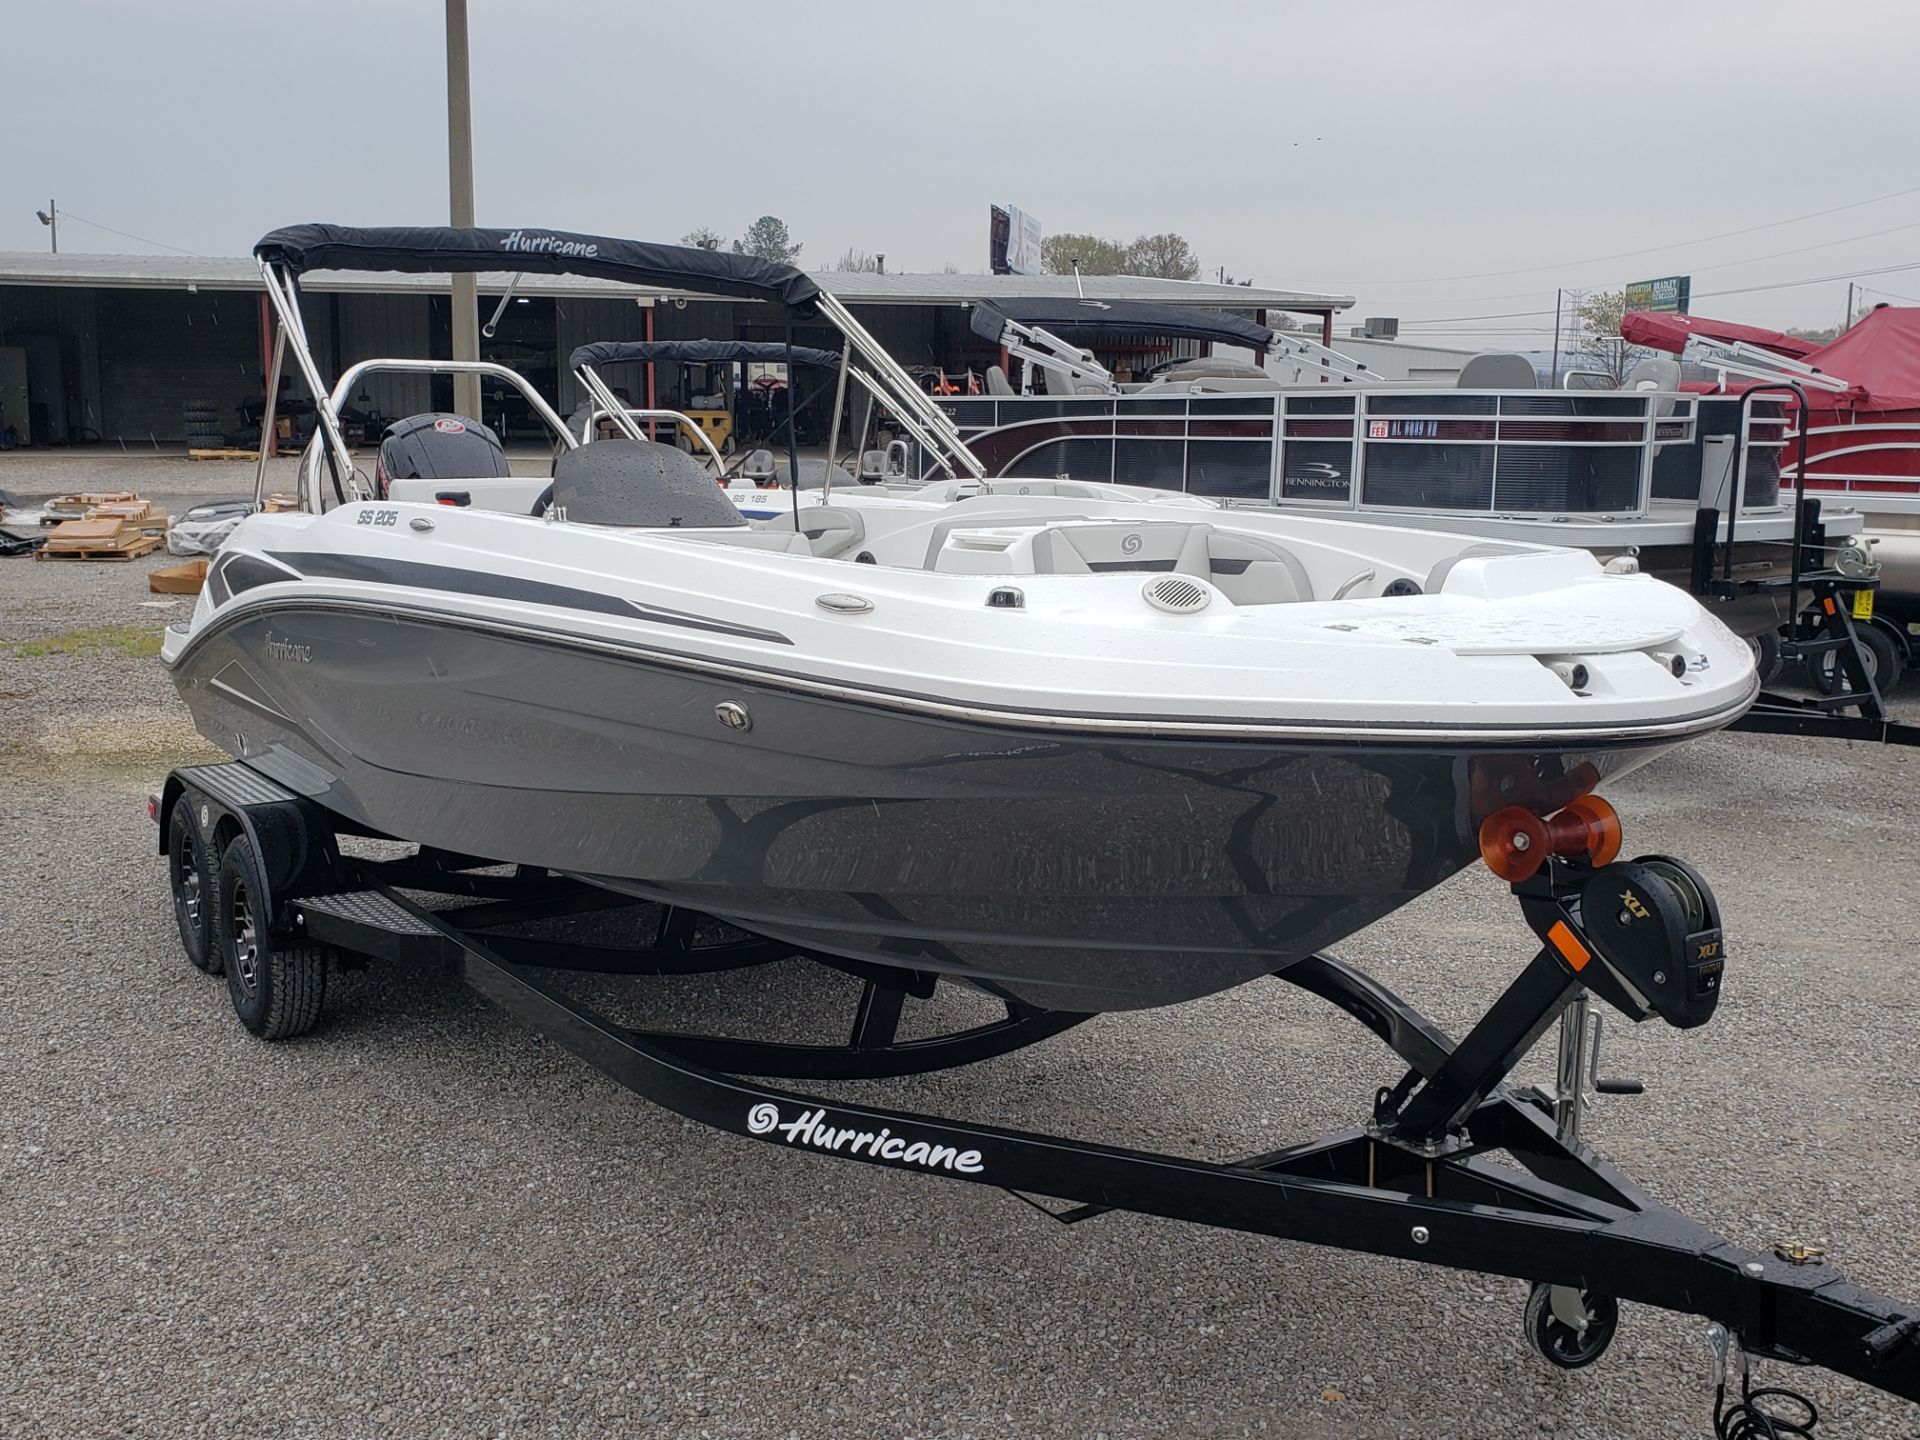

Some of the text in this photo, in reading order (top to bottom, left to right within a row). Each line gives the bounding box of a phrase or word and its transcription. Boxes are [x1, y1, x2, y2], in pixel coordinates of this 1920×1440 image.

[500, 230, 598, 257] Hurricane
[1371, 426, 1386, 437] FEB
[1285, 477, 1350, 488] BENNINGTON
[357, 509, 399, 527] SS 205
[1619, 889, 1650, 918] XLT
[1697, 943, 1719, 960] XLT
[778, 1109, 984, 1173] Hurricane
